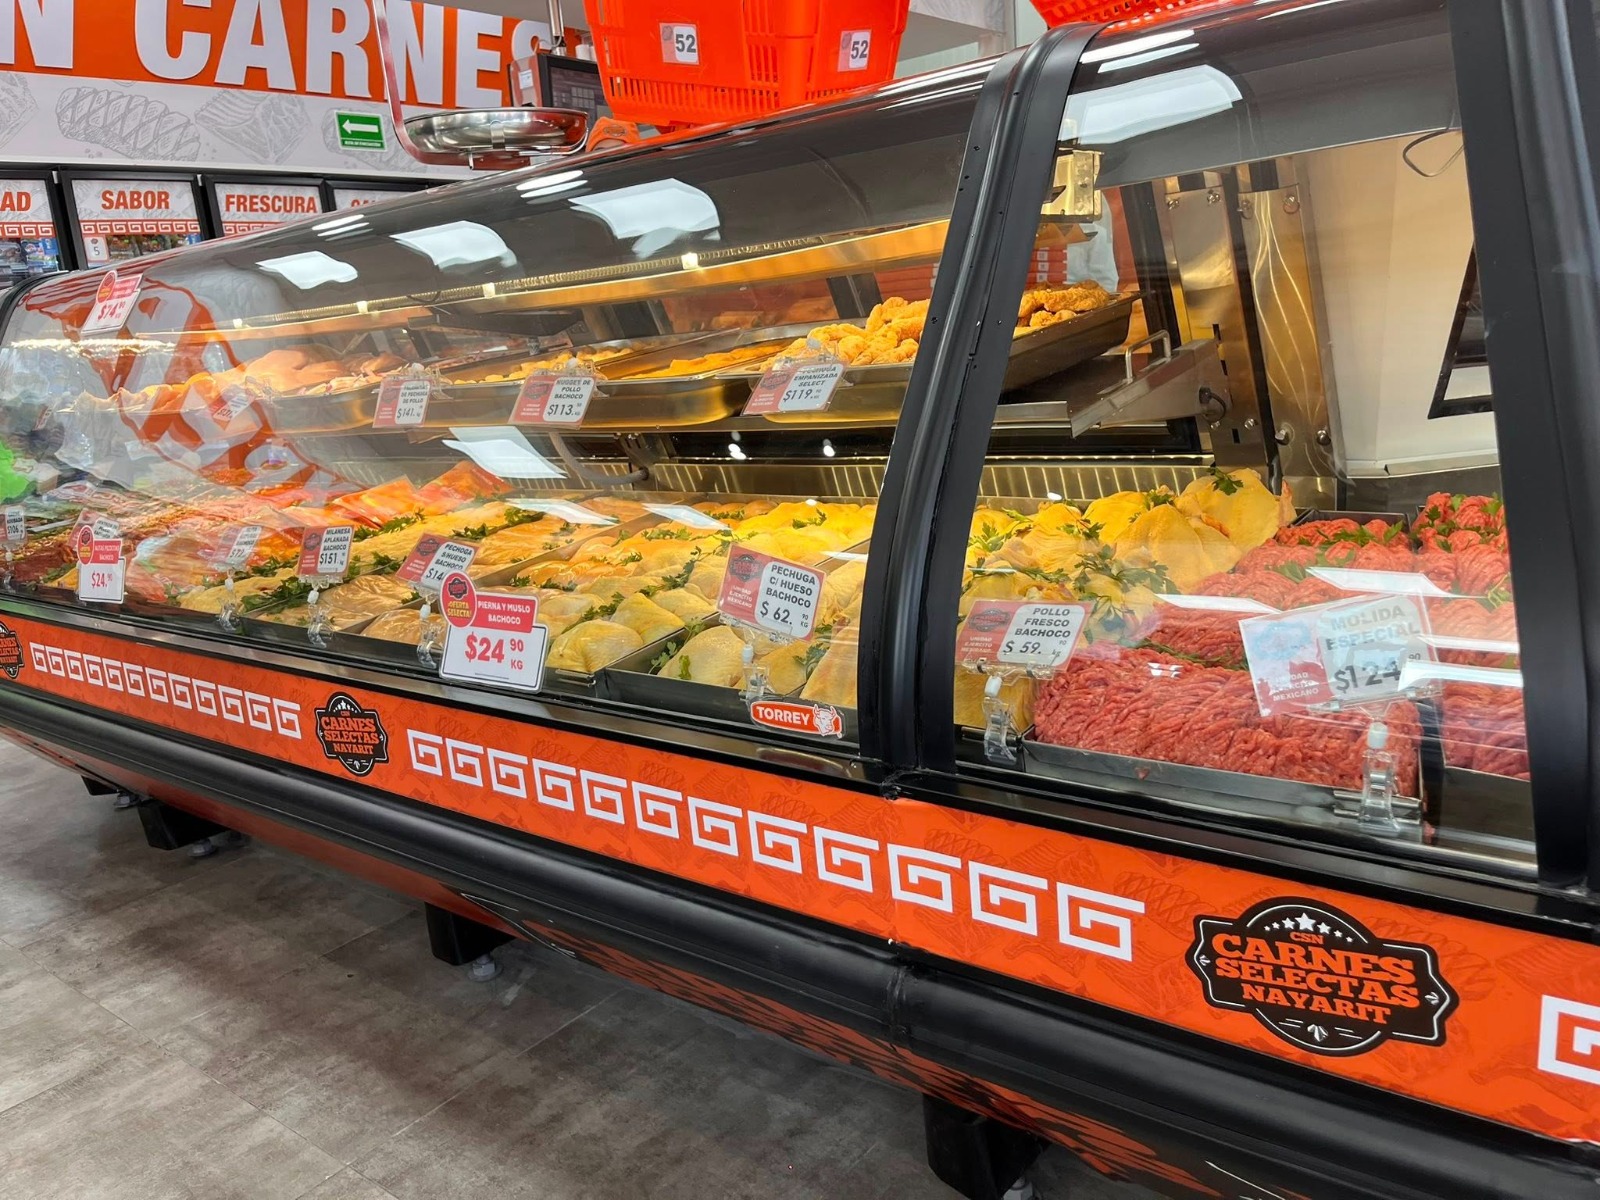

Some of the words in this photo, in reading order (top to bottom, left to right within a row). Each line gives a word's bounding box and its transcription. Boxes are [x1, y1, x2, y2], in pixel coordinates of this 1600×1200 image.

[675, 34, 697, 53] 52
[850, 40, 869, 60] 52
[0, 191, 31, 212] AD
[101, 190, 170, 210] SABOR
[225, 194, 318, 214] FRESCURA
[93, 246, 101, 256] 5
[97, 302, 119, 321] $74
[794, 373, 838, 381] EMPANIZADA
[547, 403, 574, 416] $113.
[435, 558, 464, 570] BACHOCO
[426, 567, 447, 580] $14
[771, 564, 816, 585] PECHUGA
[770, 576, 779, 586] C/
[780, 579, 813, 596] HUESO
[766, 587, 811, 608] BACHOCO
[478, 601, 501, 611] PIERNA
[502, 603, 507, 612] Y
[507, 604, 531, 614] MUSLO
[760, 600, 769, 618] $
[773, 607, 793, 625] 62.
[1033, 607, 1070, 616] POLLO
[488, 614, 521, 625] BACHOCO
[1024, 617, 1070, 627] FRESCO
[1331, 604, 1406, 631] MOLIDA
[1014, 628, 1071, 638] BACHOCO
[1325, 622, 1420, 651] ESPECIAL
[465, 631, 505, 663] $24
[510, 638, 524, 652] 90
[1002, 640, 1015, 655] $
[1019, 641, 1042, 654] 59.
[510, 659, 524, 670] KG
[1272, 687, 1319, 701] MEXICANO
[321, 716, 376, 732] CARNES
[756, 705, 810, 726] TORREY
[324, 730, 380, 745] SELECTAS
[333, 743, 374, 755] NAYARIT
[1290, 932, 1324, 945] CSN
[1211, 933, 1417, 985] CARNES
[1215, 957, 1420, 1009] SELECTAS
[1241, 983, 1391, 1024] NAYARIT
